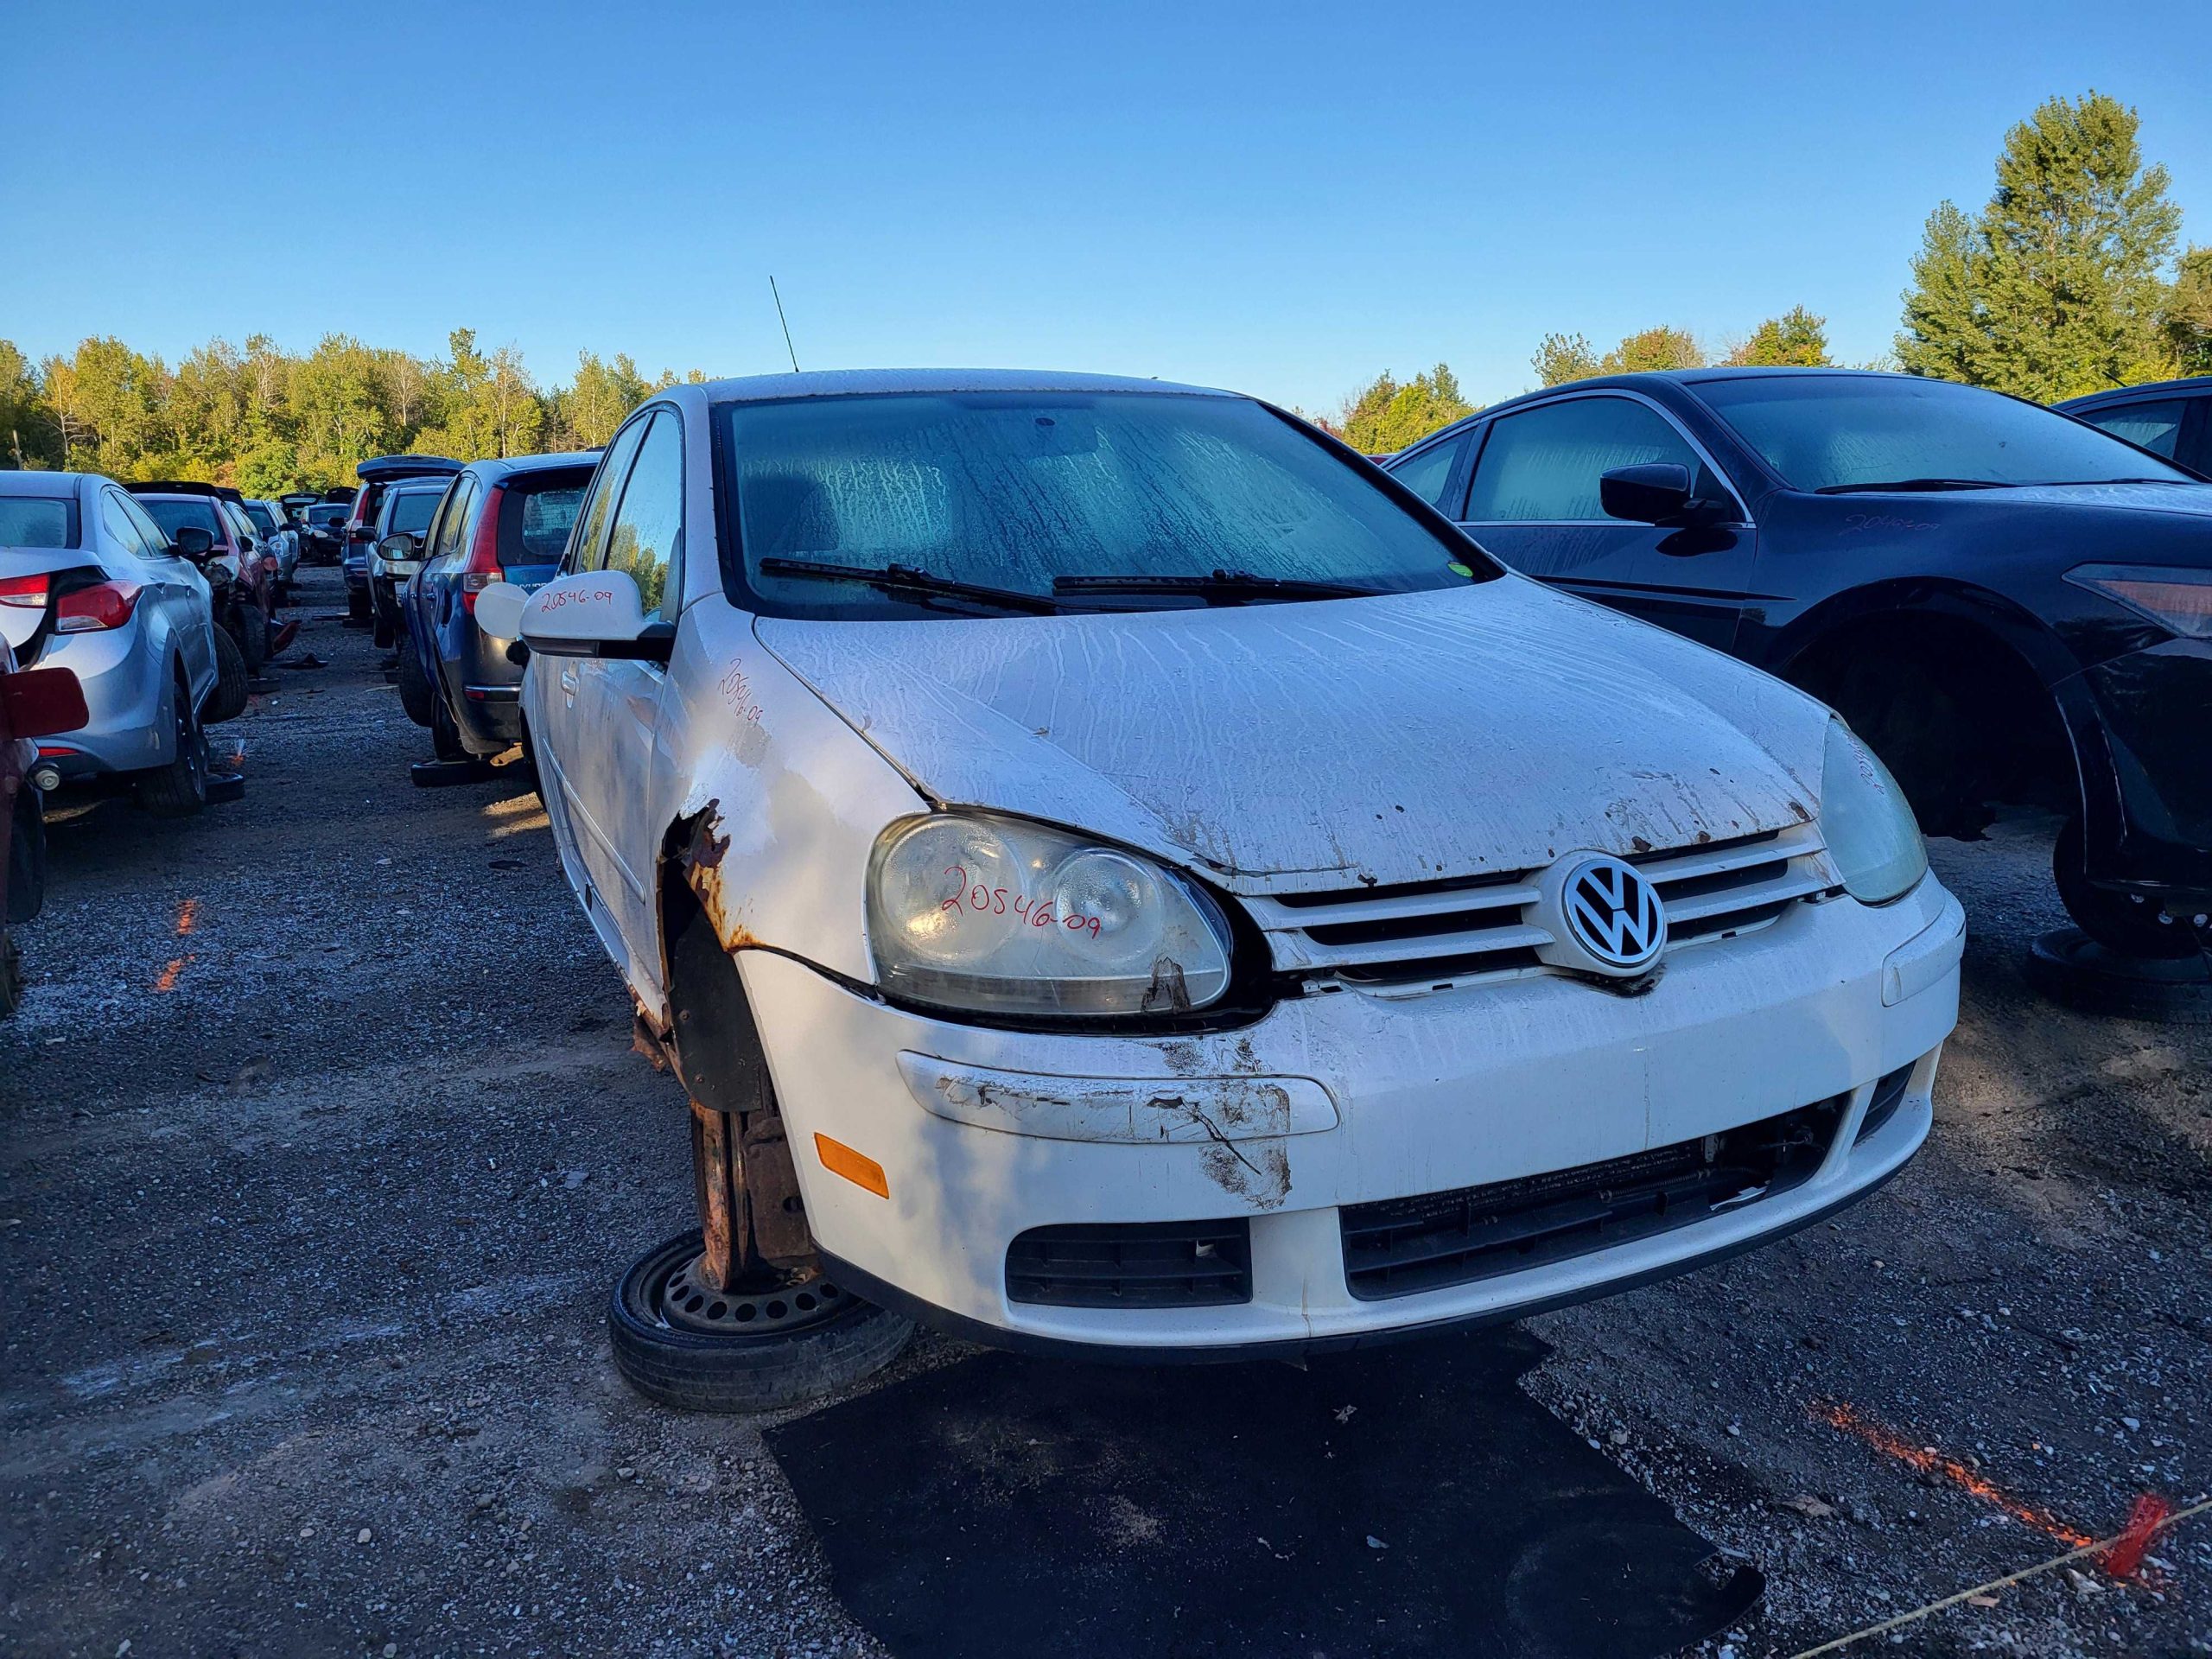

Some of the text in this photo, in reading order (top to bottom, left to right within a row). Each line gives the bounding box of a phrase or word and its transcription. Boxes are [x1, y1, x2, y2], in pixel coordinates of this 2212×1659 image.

[541, 589, 613, 613] 20546-09
[941, 866, 1101, 939] 20546-09
[1565, 859, 1663, 963] VW
